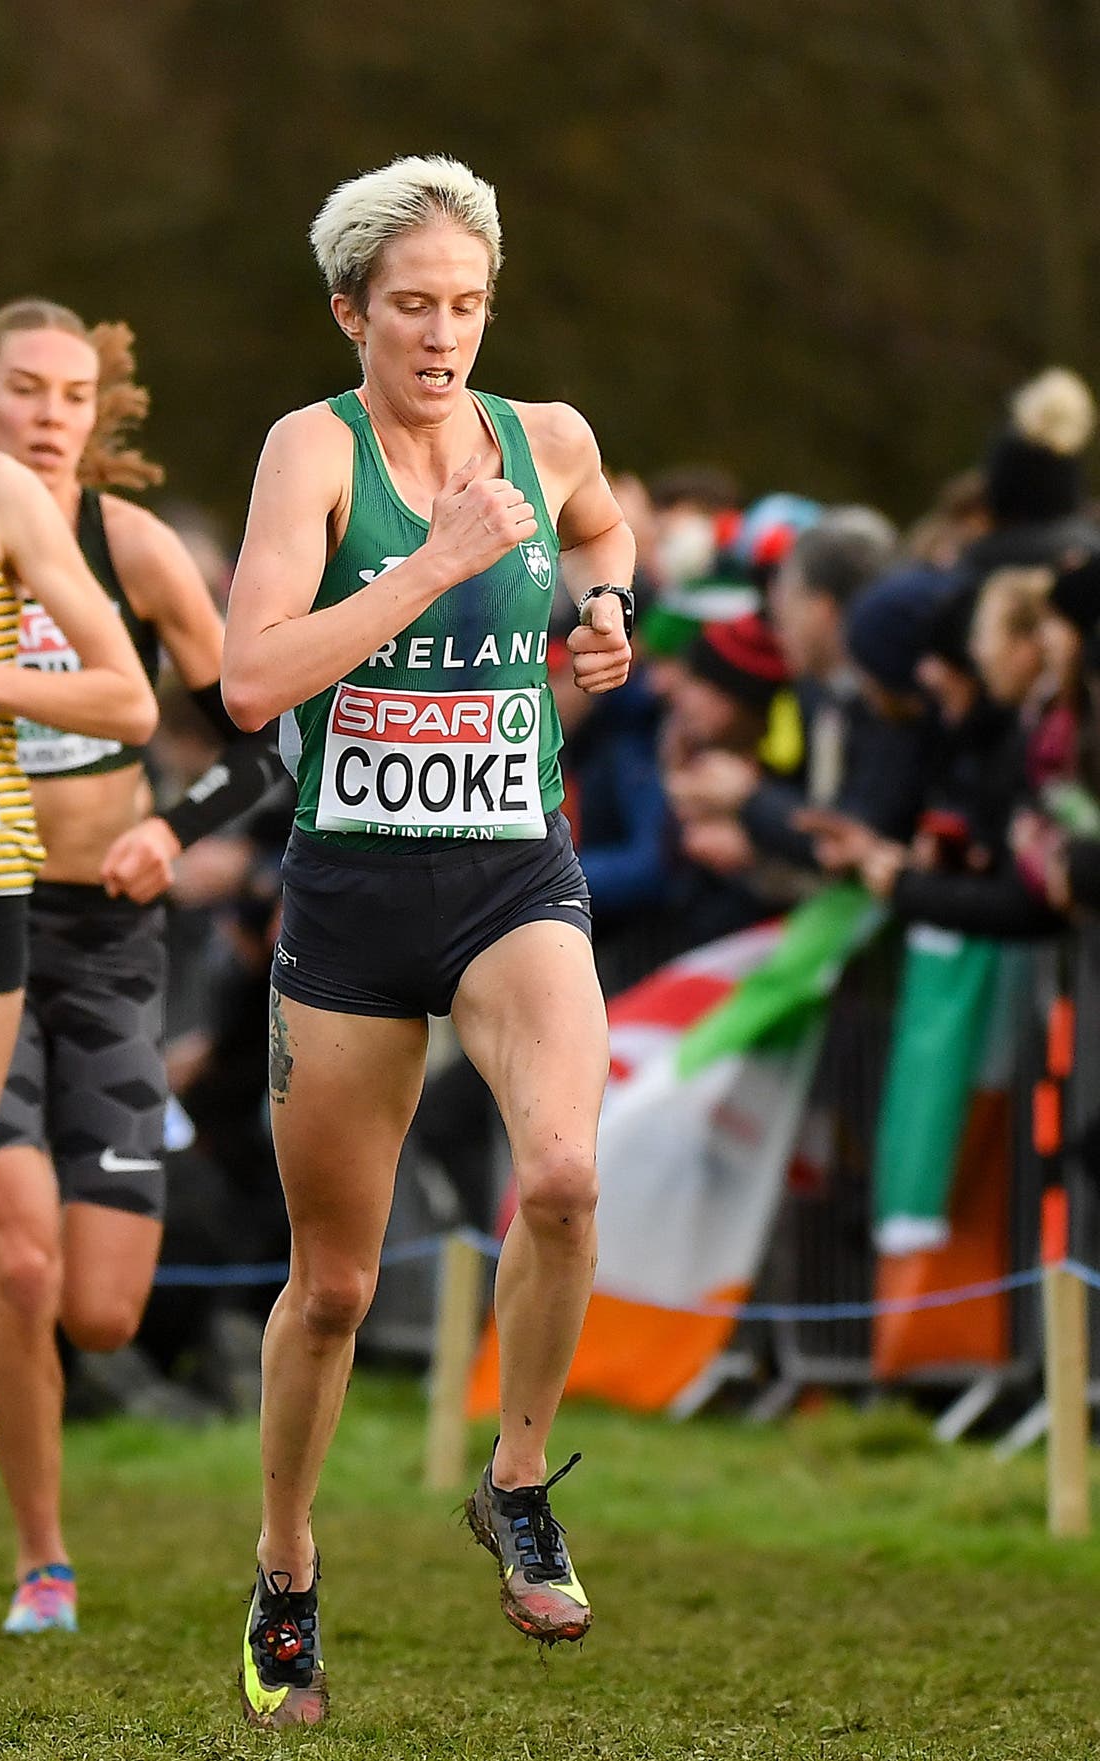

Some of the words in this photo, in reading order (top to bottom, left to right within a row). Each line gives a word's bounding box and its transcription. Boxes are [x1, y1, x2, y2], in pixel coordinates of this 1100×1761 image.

[369, 631, 547, 669] RELAND
[338, 695, 490, 737] SPAR
[335, 746, 528, 813] COOKE
